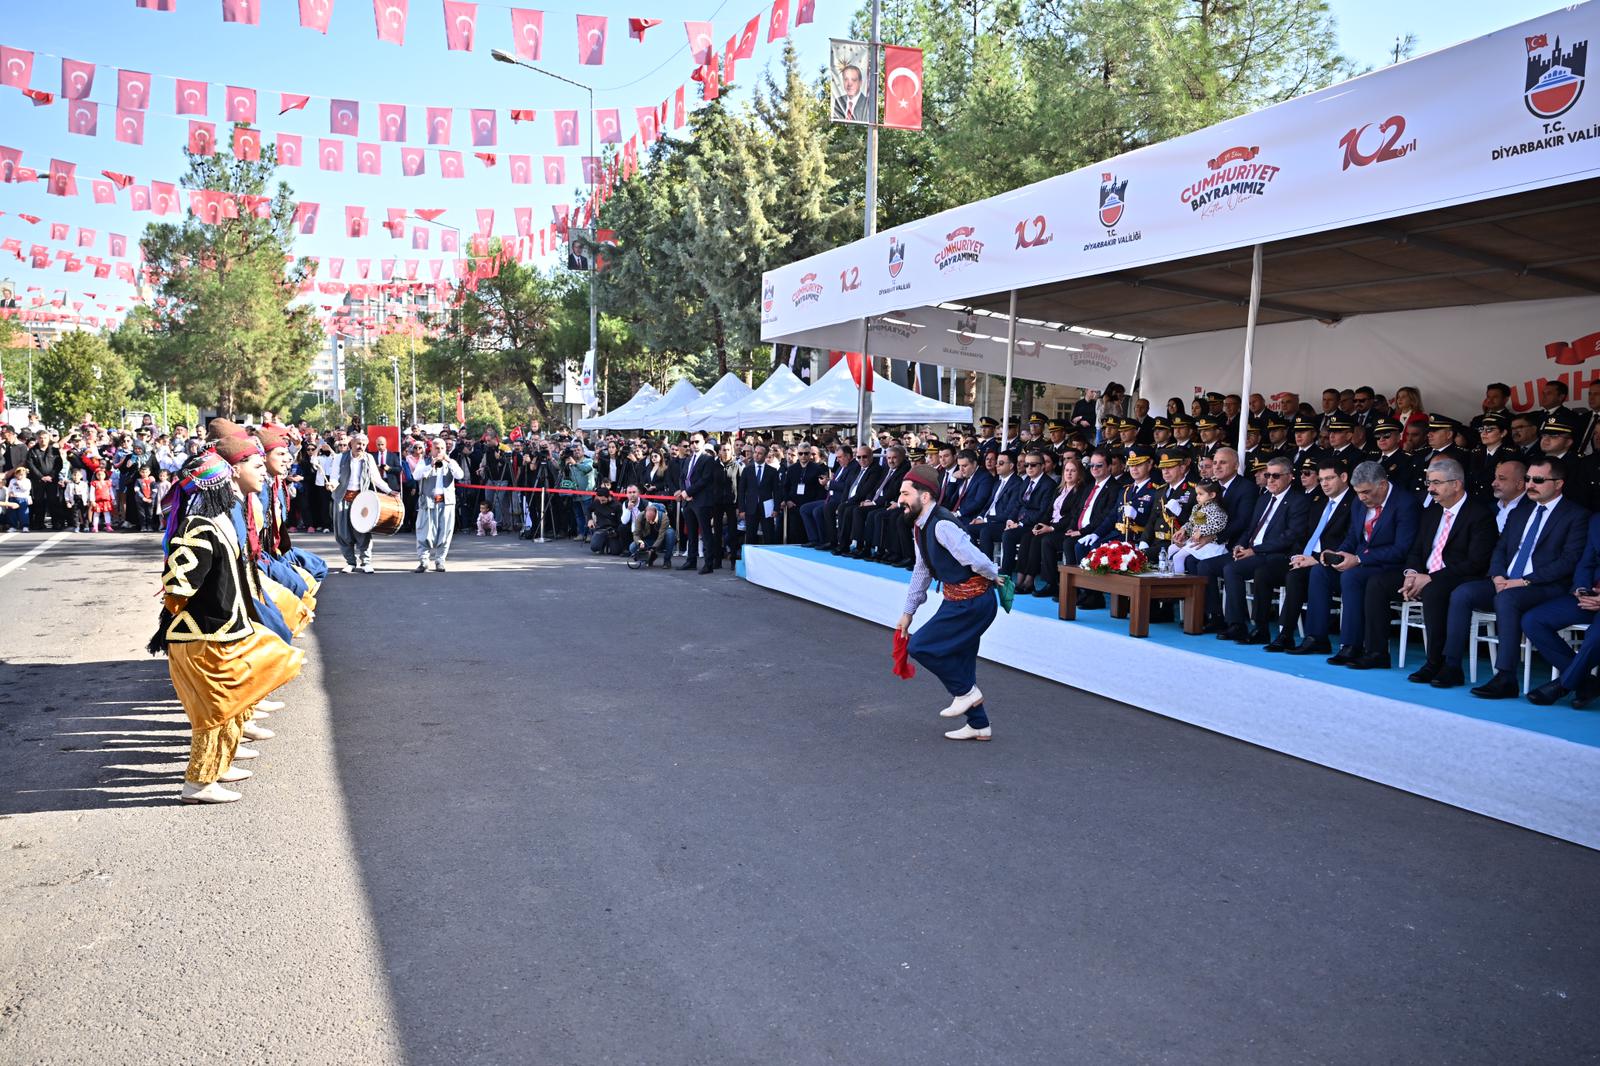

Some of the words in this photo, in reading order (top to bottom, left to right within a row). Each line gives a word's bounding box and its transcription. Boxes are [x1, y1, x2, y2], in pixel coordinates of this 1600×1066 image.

[1542, 121, 1565, 134] T.C.
[1491, 135, 1564, 160] DİYARBAKIR
[1567, 124, 1600, 143] VALİ
[1180, 164, 1280, 203] CUMHURİYET
[1191, 182, 1265, 211] BAYRAMIMIZ
[1107, 229, 1117, 237] T.C.
[934, 239, 984, 264] CUMHURİYET
[1083, 238, 1117, 251] DİYARBAKIR
[940, 252, 979, 270] BAYRAMIMIZ
